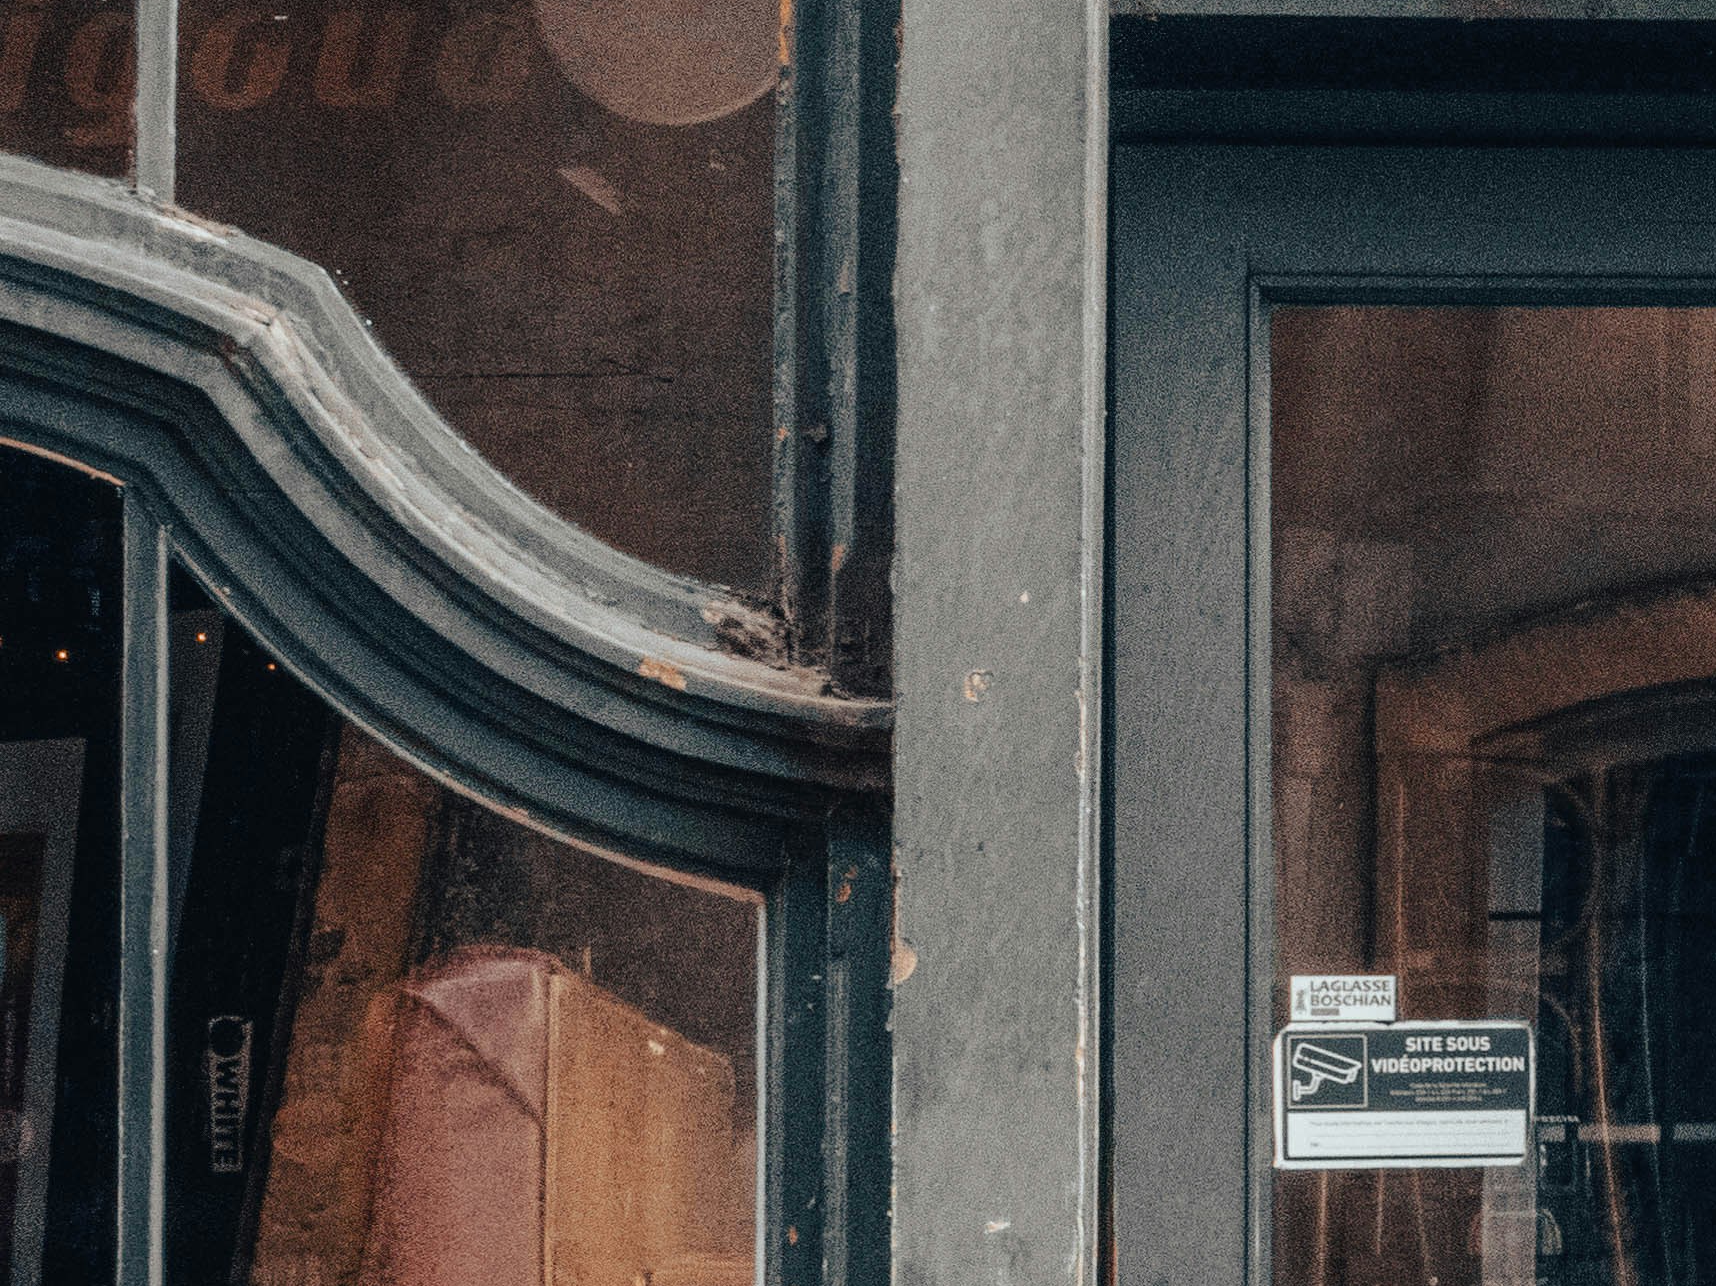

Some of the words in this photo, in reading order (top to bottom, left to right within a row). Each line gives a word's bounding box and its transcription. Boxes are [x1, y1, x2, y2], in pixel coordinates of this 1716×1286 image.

[1310, 994, 1392, 1007] BOSCHIAN
[1405, 1036, 1443, 1052] SITE
[1446, 1036, 1491, 1052] SOUS
[1371, 1053, 1526, 1074] VIDÉOPROTECTION
[214, 1059, 241, 1166] WHITE
